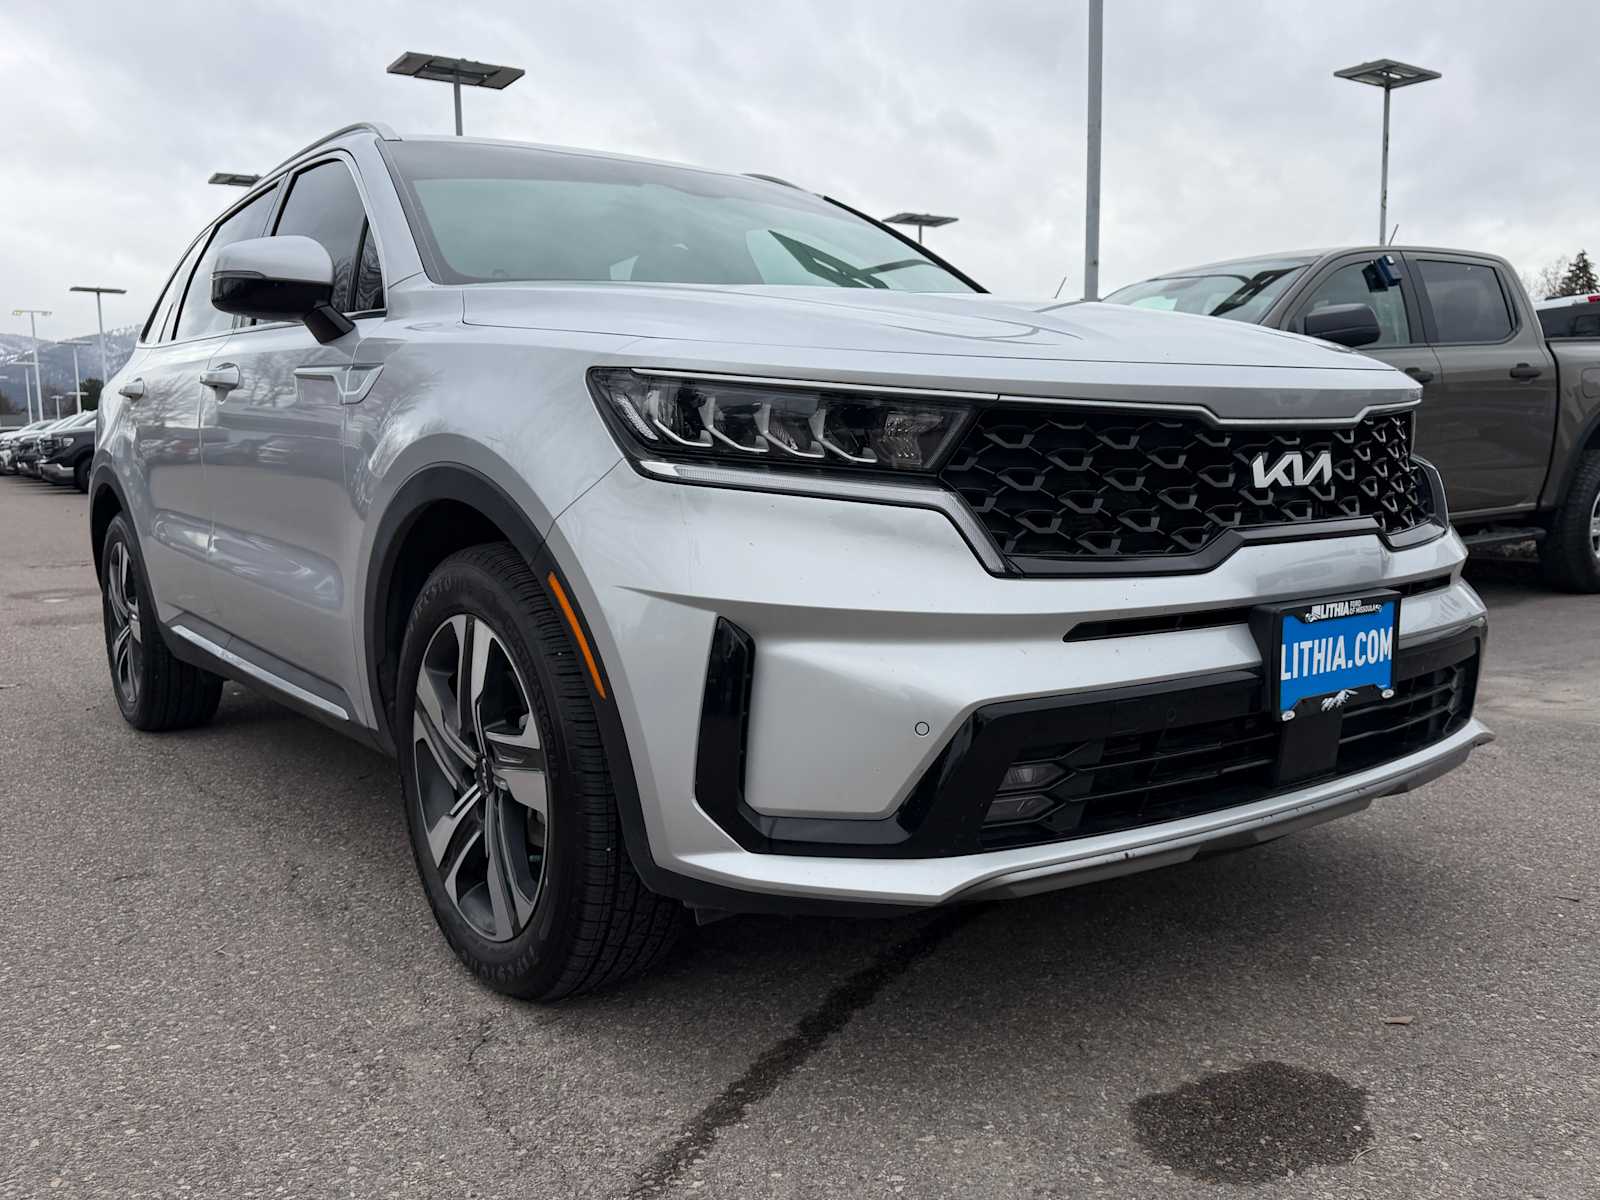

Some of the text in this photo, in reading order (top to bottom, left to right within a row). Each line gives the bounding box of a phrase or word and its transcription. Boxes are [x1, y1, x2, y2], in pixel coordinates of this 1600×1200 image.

[1252, 452, 1332, 488] KIA
[1320, 601, 1349, 619] LITHIA
[1281, 626, 1393, 681] LITHIA.COM
